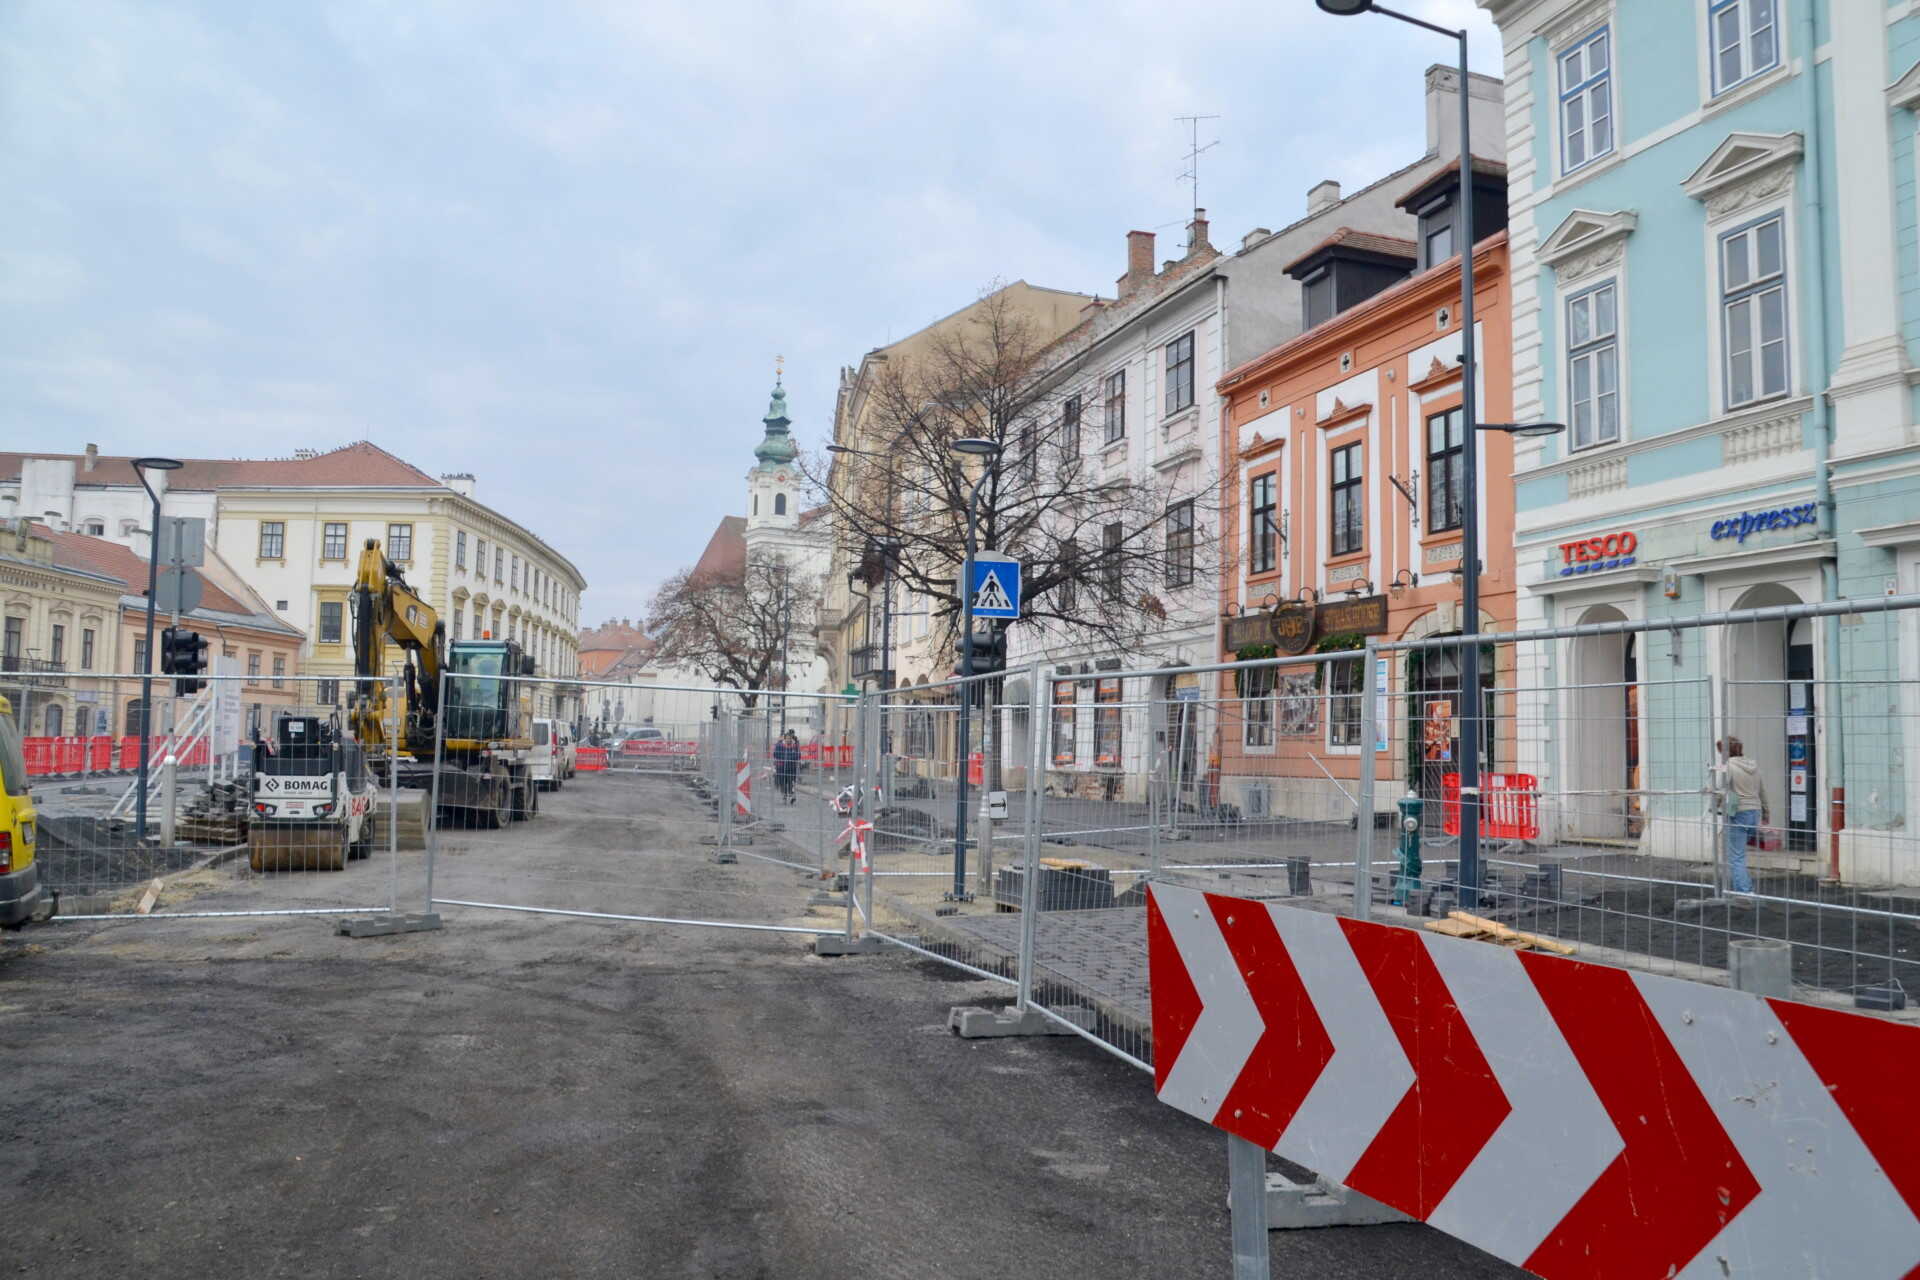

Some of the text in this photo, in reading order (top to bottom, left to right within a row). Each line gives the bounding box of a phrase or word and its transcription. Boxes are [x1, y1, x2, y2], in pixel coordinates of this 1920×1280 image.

[1558, 502, 1817, 564] TESCO expressz
[284, 780, 328, 791] BOMAG
